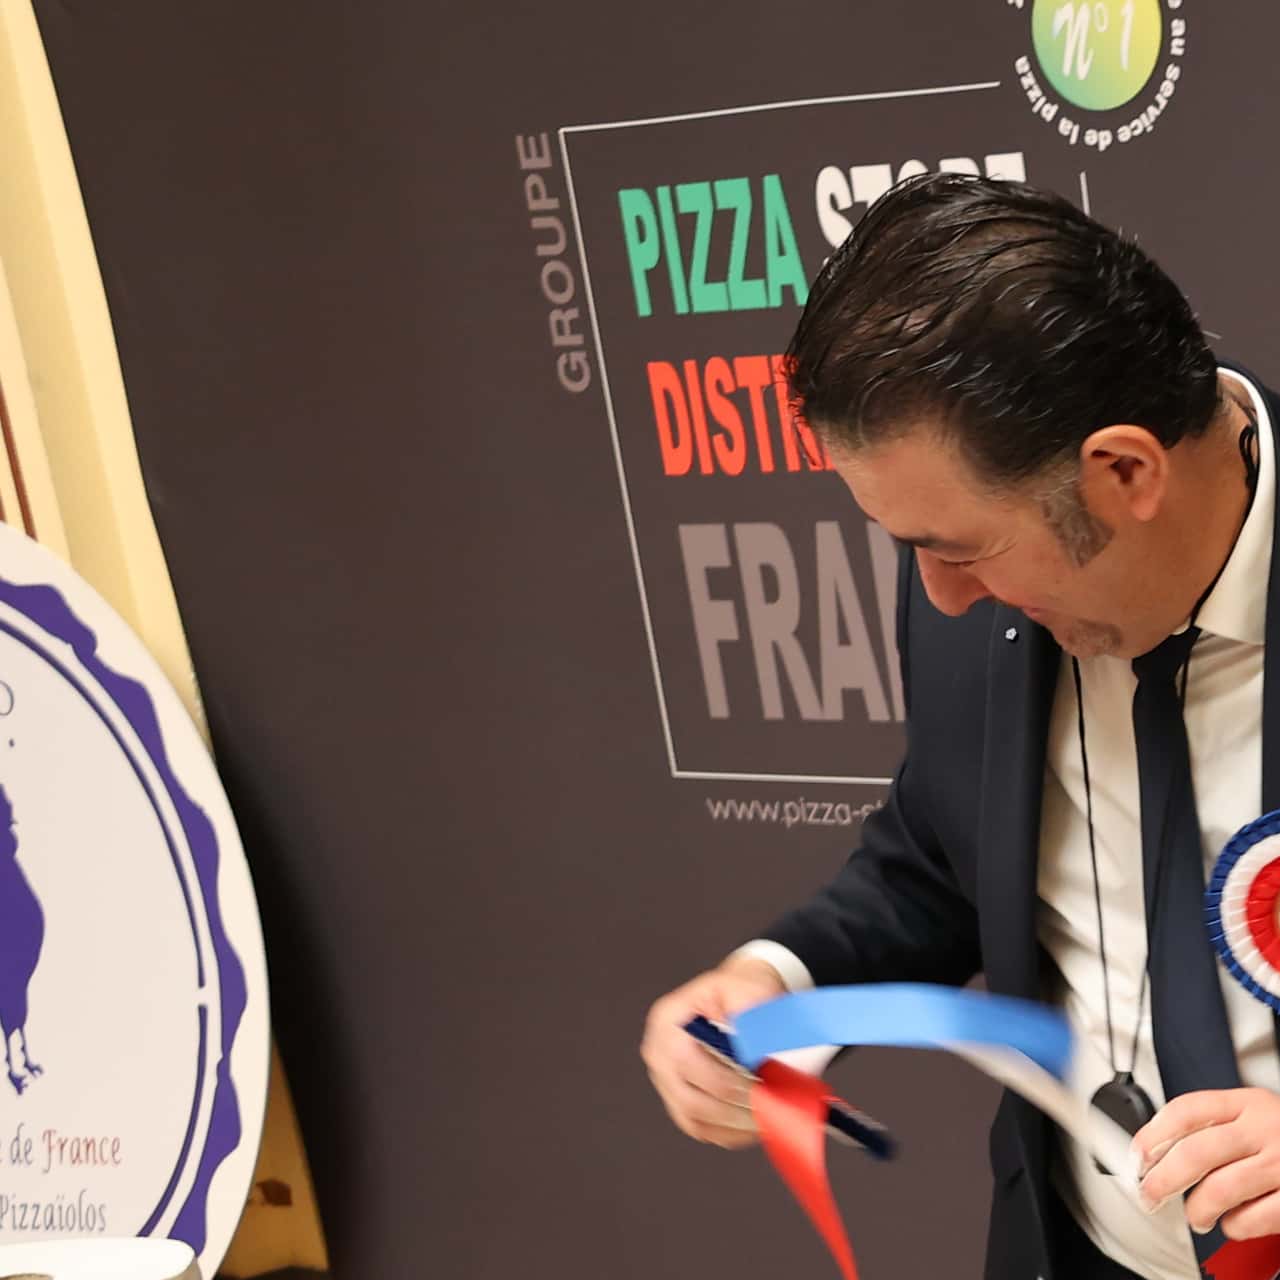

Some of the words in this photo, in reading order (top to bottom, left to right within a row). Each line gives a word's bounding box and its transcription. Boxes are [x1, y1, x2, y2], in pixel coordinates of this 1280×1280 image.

[1170, 19, 1186, 56] au
[1015, 56, 1059, 122] pizza
[1117, 63, 1181, 143] service
[1058, 117, 1080, 145] la
[1084, 129, 1113, 152] de
[515, 132, 590, 393] GROUPE
[618, 174, 808, 317] PIZZA
[647, 354, 836, 478] DISTR
[10, 1122, 33, 1165] de
[42, 1128, 121, 1174] France
